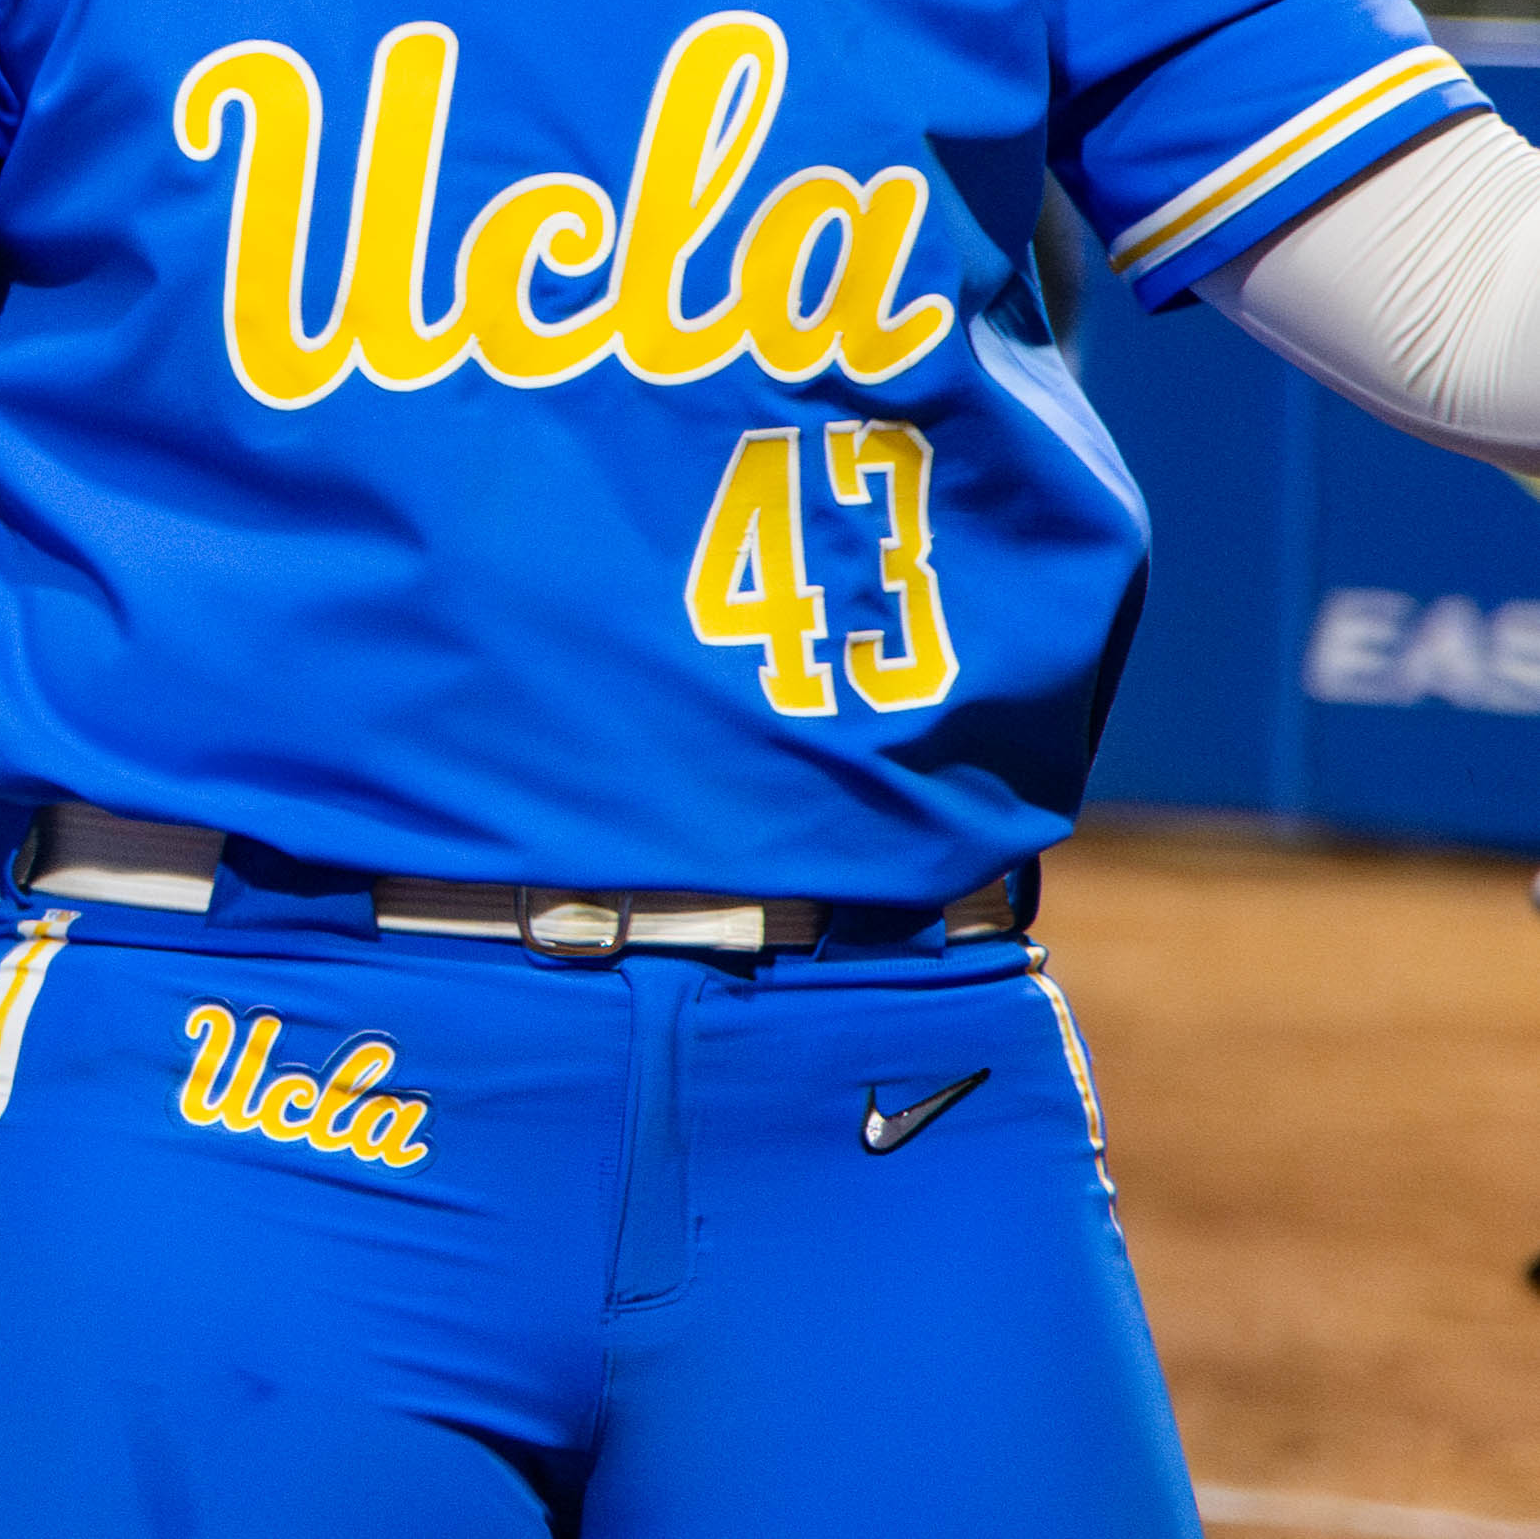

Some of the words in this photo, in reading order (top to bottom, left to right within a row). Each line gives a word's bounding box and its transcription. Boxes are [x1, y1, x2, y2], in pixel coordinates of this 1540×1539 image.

[174, 9, 954, 410] Ucla
[684, 419, 959, 718] 43
[179, 1002, 430, 1171] Ucla
